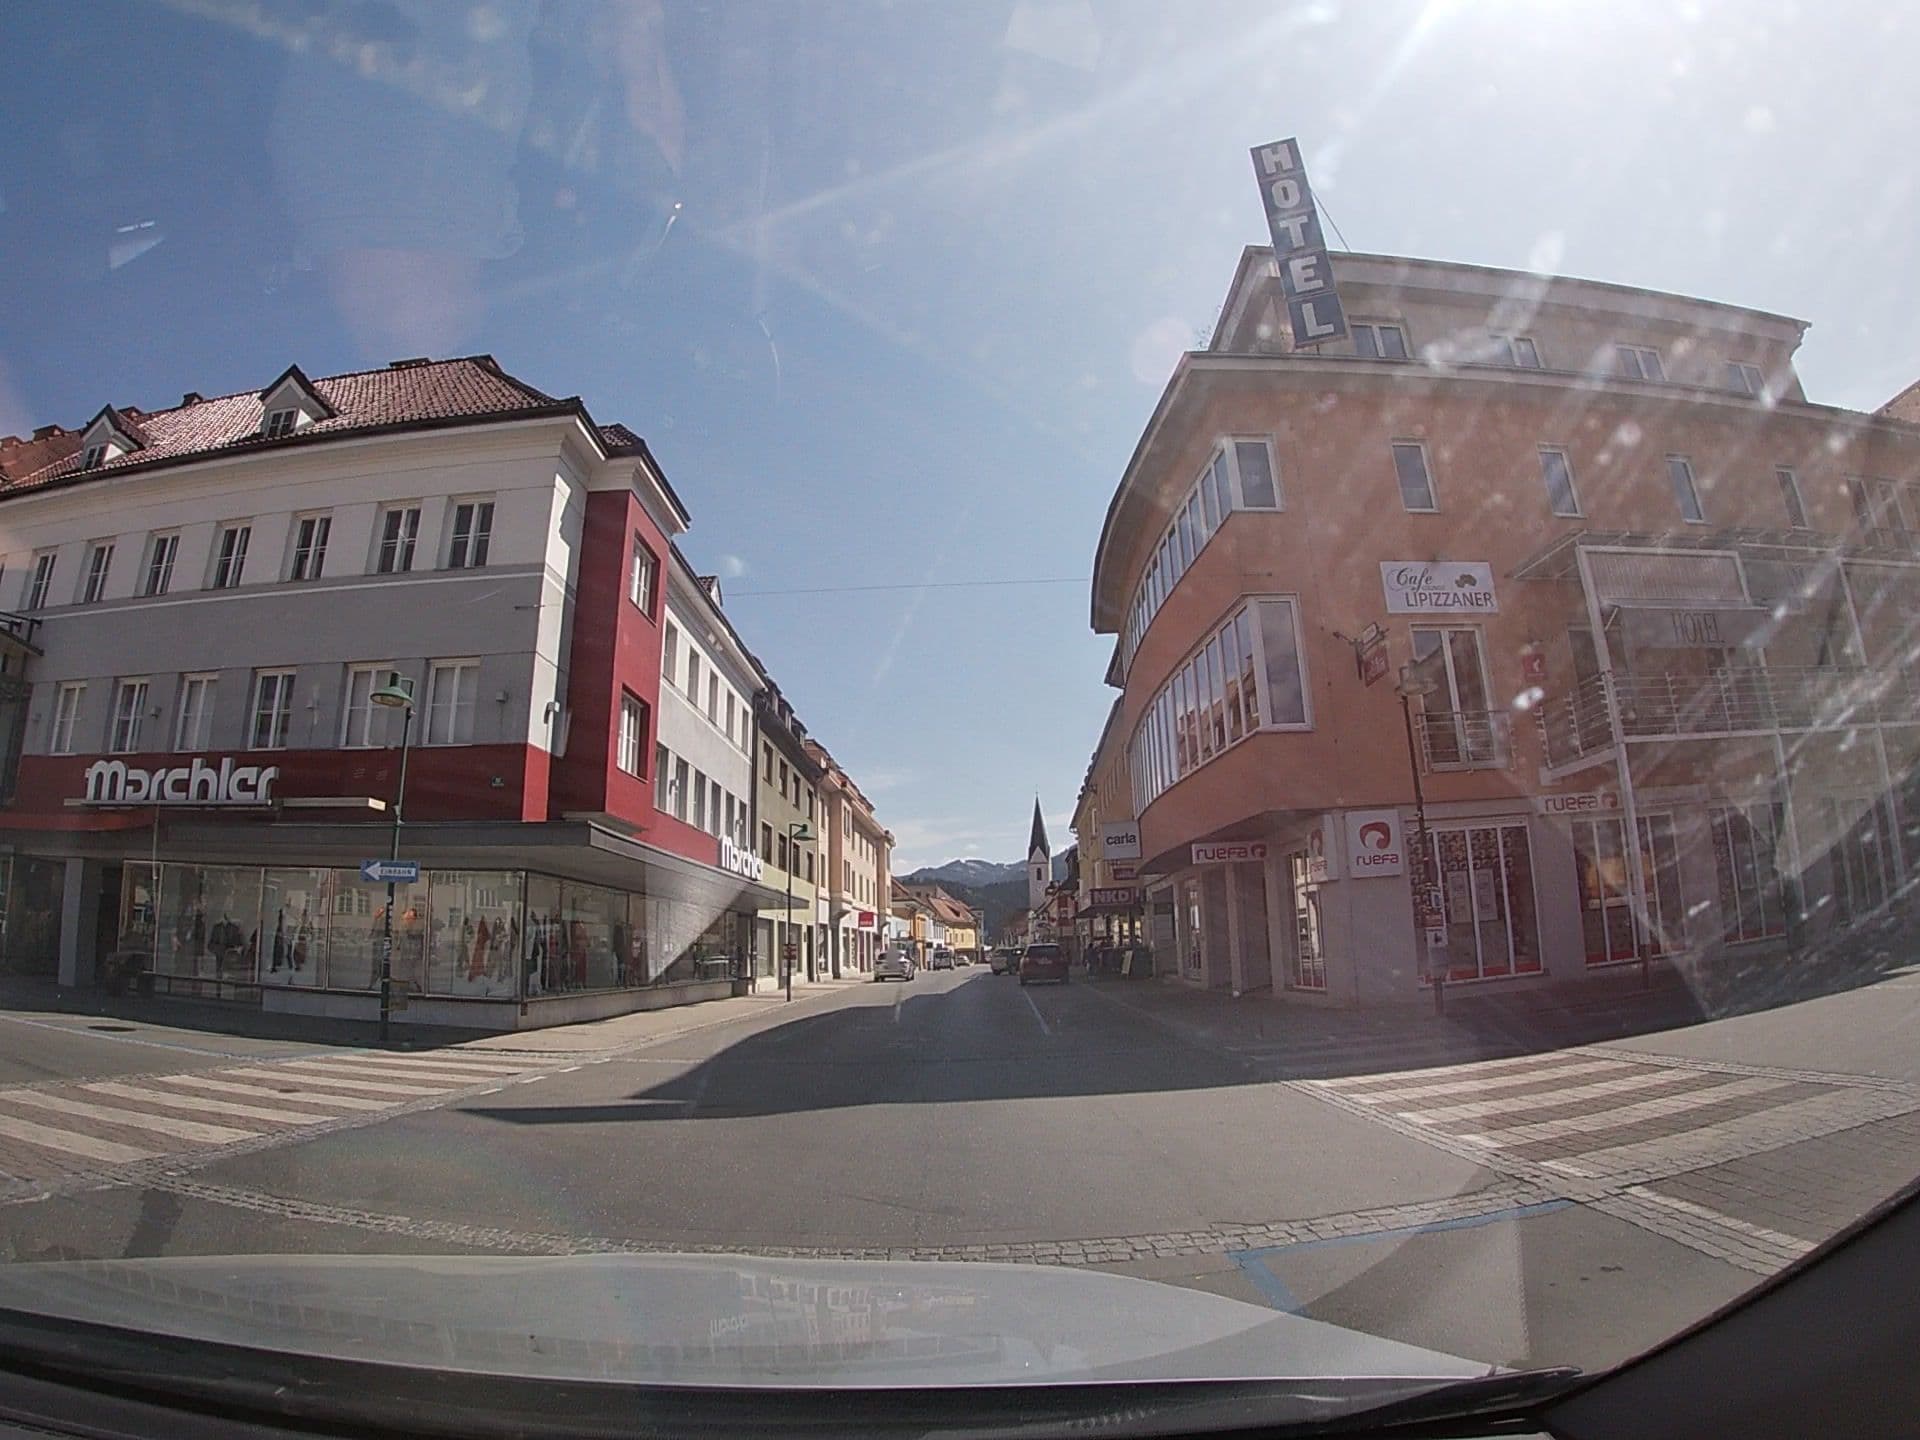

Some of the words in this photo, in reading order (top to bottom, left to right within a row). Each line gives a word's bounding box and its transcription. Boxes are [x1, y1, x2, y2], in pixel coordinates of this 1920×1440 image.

[1261, 143, 1335, 338] HOTEL
[1405, 592, 1494, 607] LIPIZZANER
[1672, 612, 1726, 644] HOTEL
[1544, 795, 1598, 811] ruefa
[1106, 833, 1136, 845] carla
[1196, 846, 1248, 861] ruefa
[1356, 853, 1399, 866] ruefa
[1094, 890, 1130, 904] NKD
